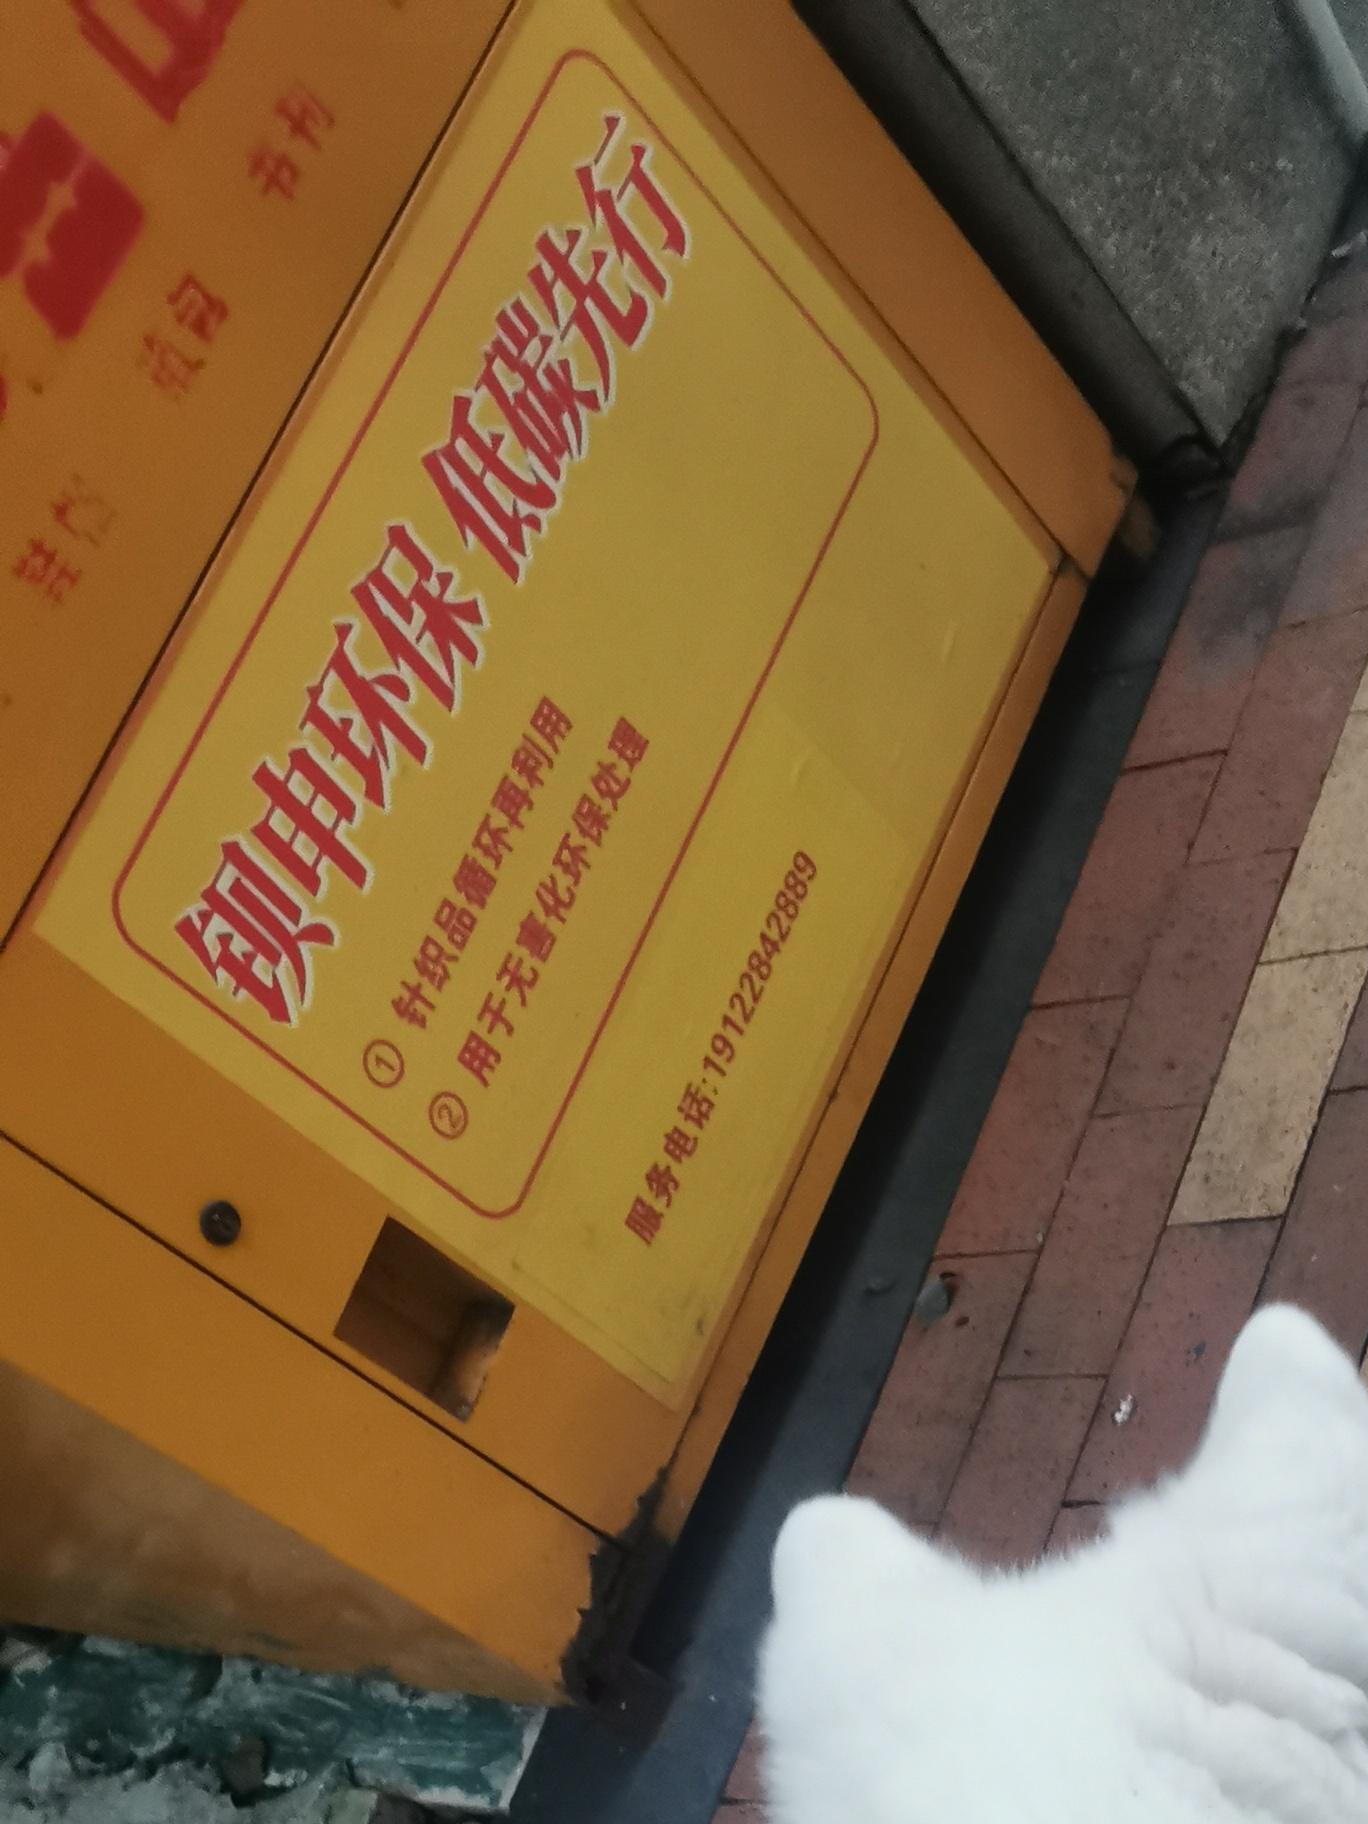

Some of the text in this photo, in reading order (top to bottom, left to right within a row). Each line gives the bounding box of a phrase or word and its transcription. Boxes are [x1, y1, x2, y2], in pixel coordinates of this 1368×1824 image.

[174, 109, 693, 1027] 钡申环保 低碳先行
[390, 695, 573, 1030] 针织品循环再利用
[455, 715, 650, 1089] 用于无害化环保处理
